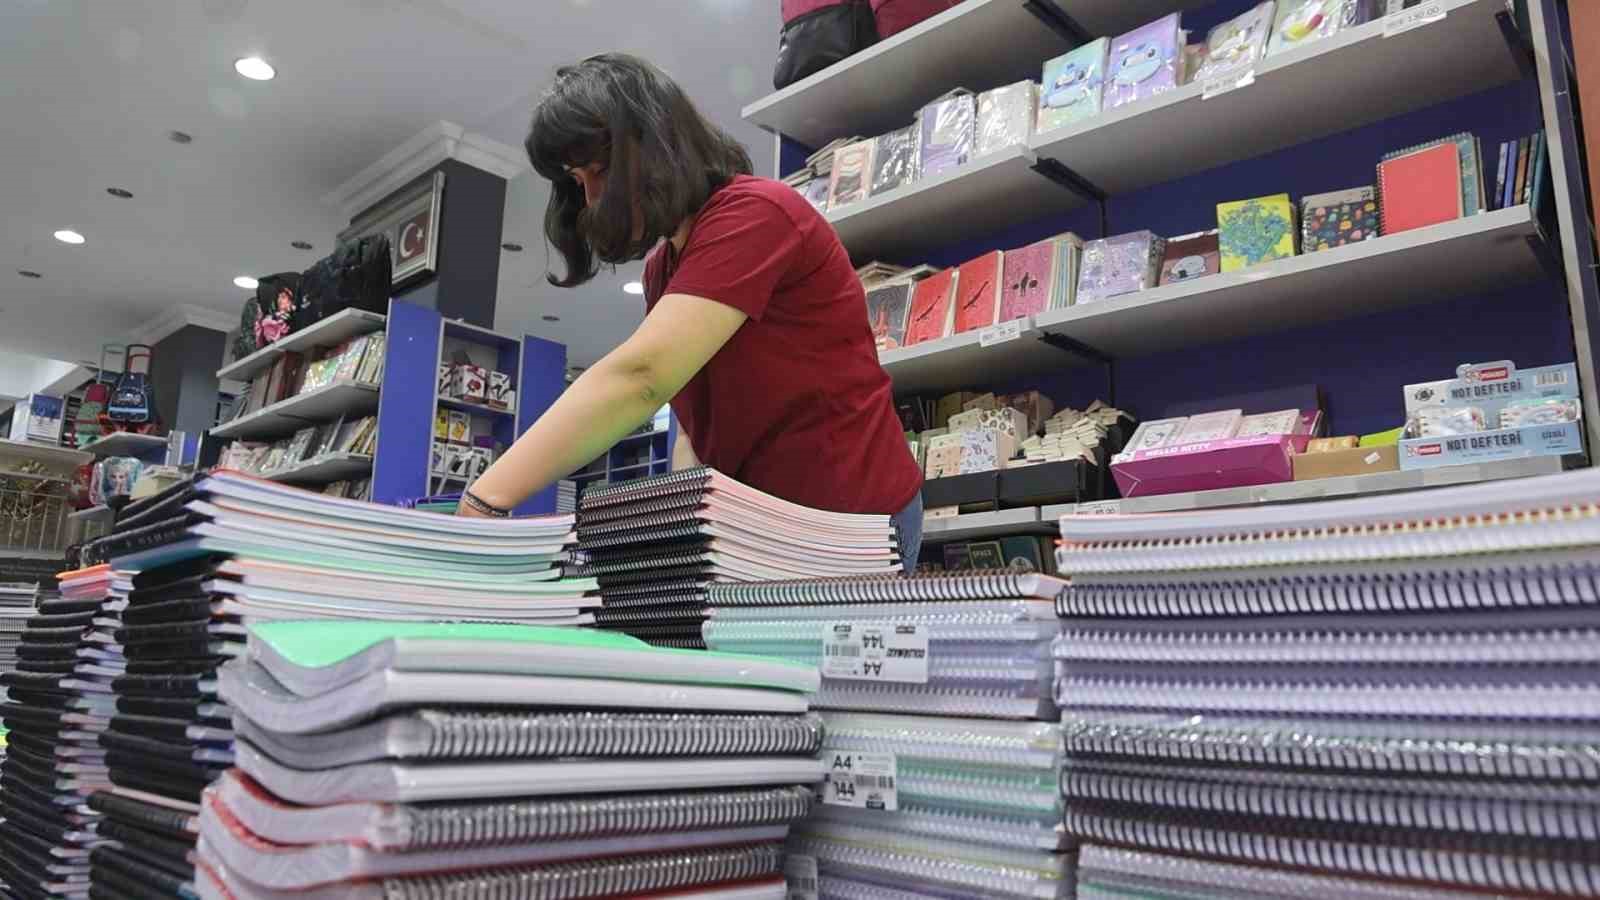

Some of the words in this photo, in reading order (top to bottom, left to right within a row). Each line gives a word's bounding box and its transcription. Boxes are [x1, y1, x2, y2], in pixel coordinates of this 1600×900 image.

[1451, 387, 1471, 398] NOT
[1474, 379, 1522, 396] DEFTERİ
[1446, 439, 1467, 451] NOT
[1470, 431, 1521, 449] DEFTERİ
[862, 634, 885, 650] 144
[863, 661, 883, 677] A4
[833, 755, 852, 769] A4
[833, 781, 856, 797] 144
